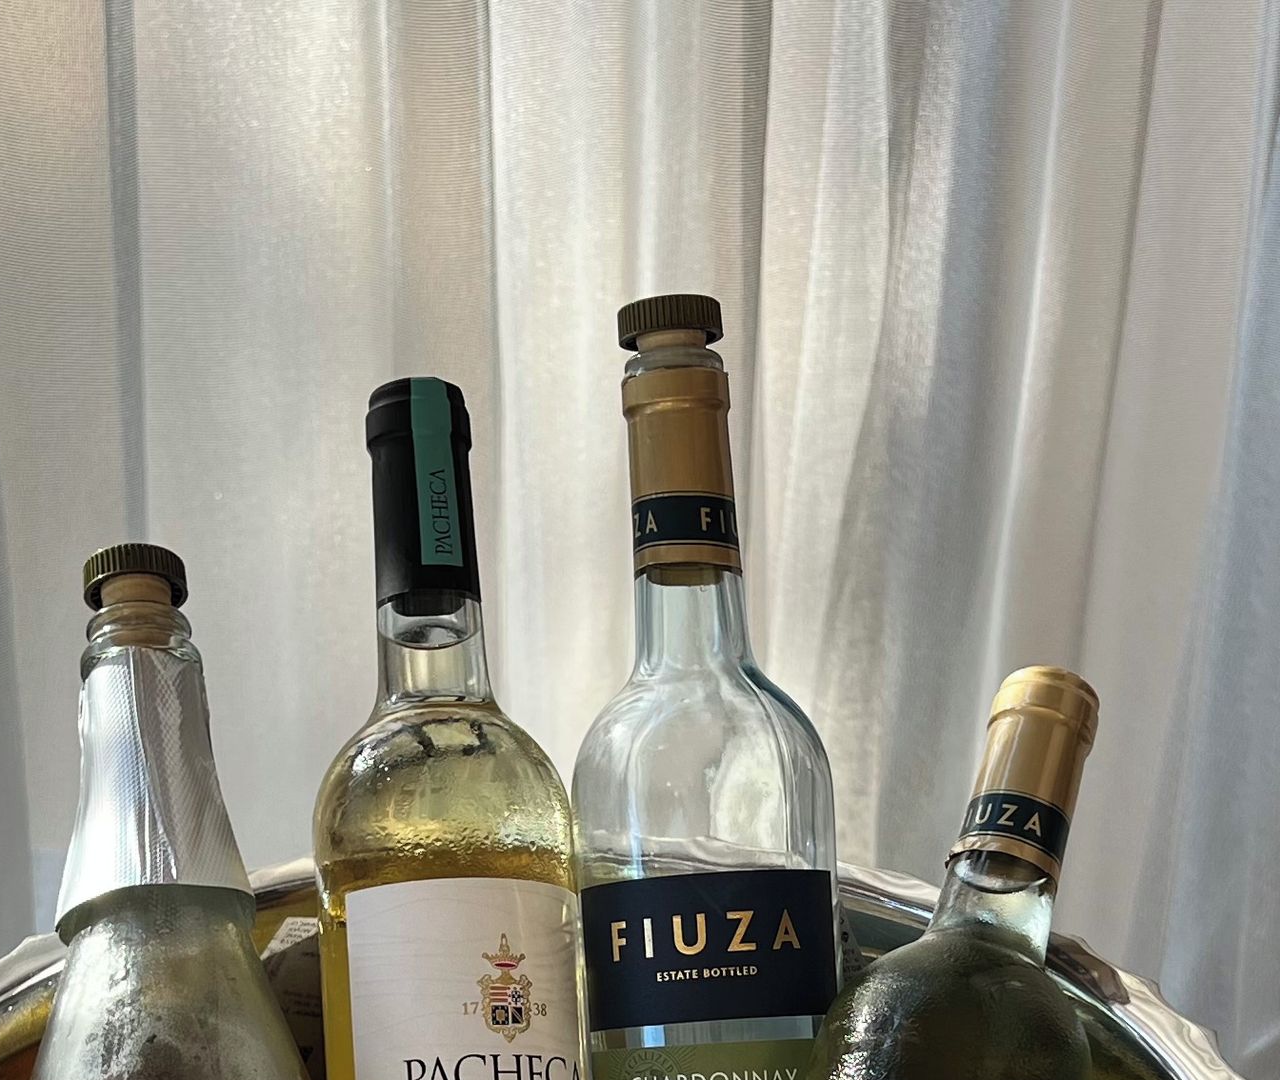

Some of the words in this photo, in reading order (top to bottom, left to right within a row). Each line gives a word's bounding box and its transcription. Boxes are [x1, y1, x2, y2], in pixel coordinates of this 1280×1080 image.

[429, 468, 452, 555] PACHECA
[610, 908, 802, 963] FIUZA
[656, 967, 699, 982] ESTATE
[703, 965, 758, 978] BOTTLED
[532, 1002, 548, 1017] 38
